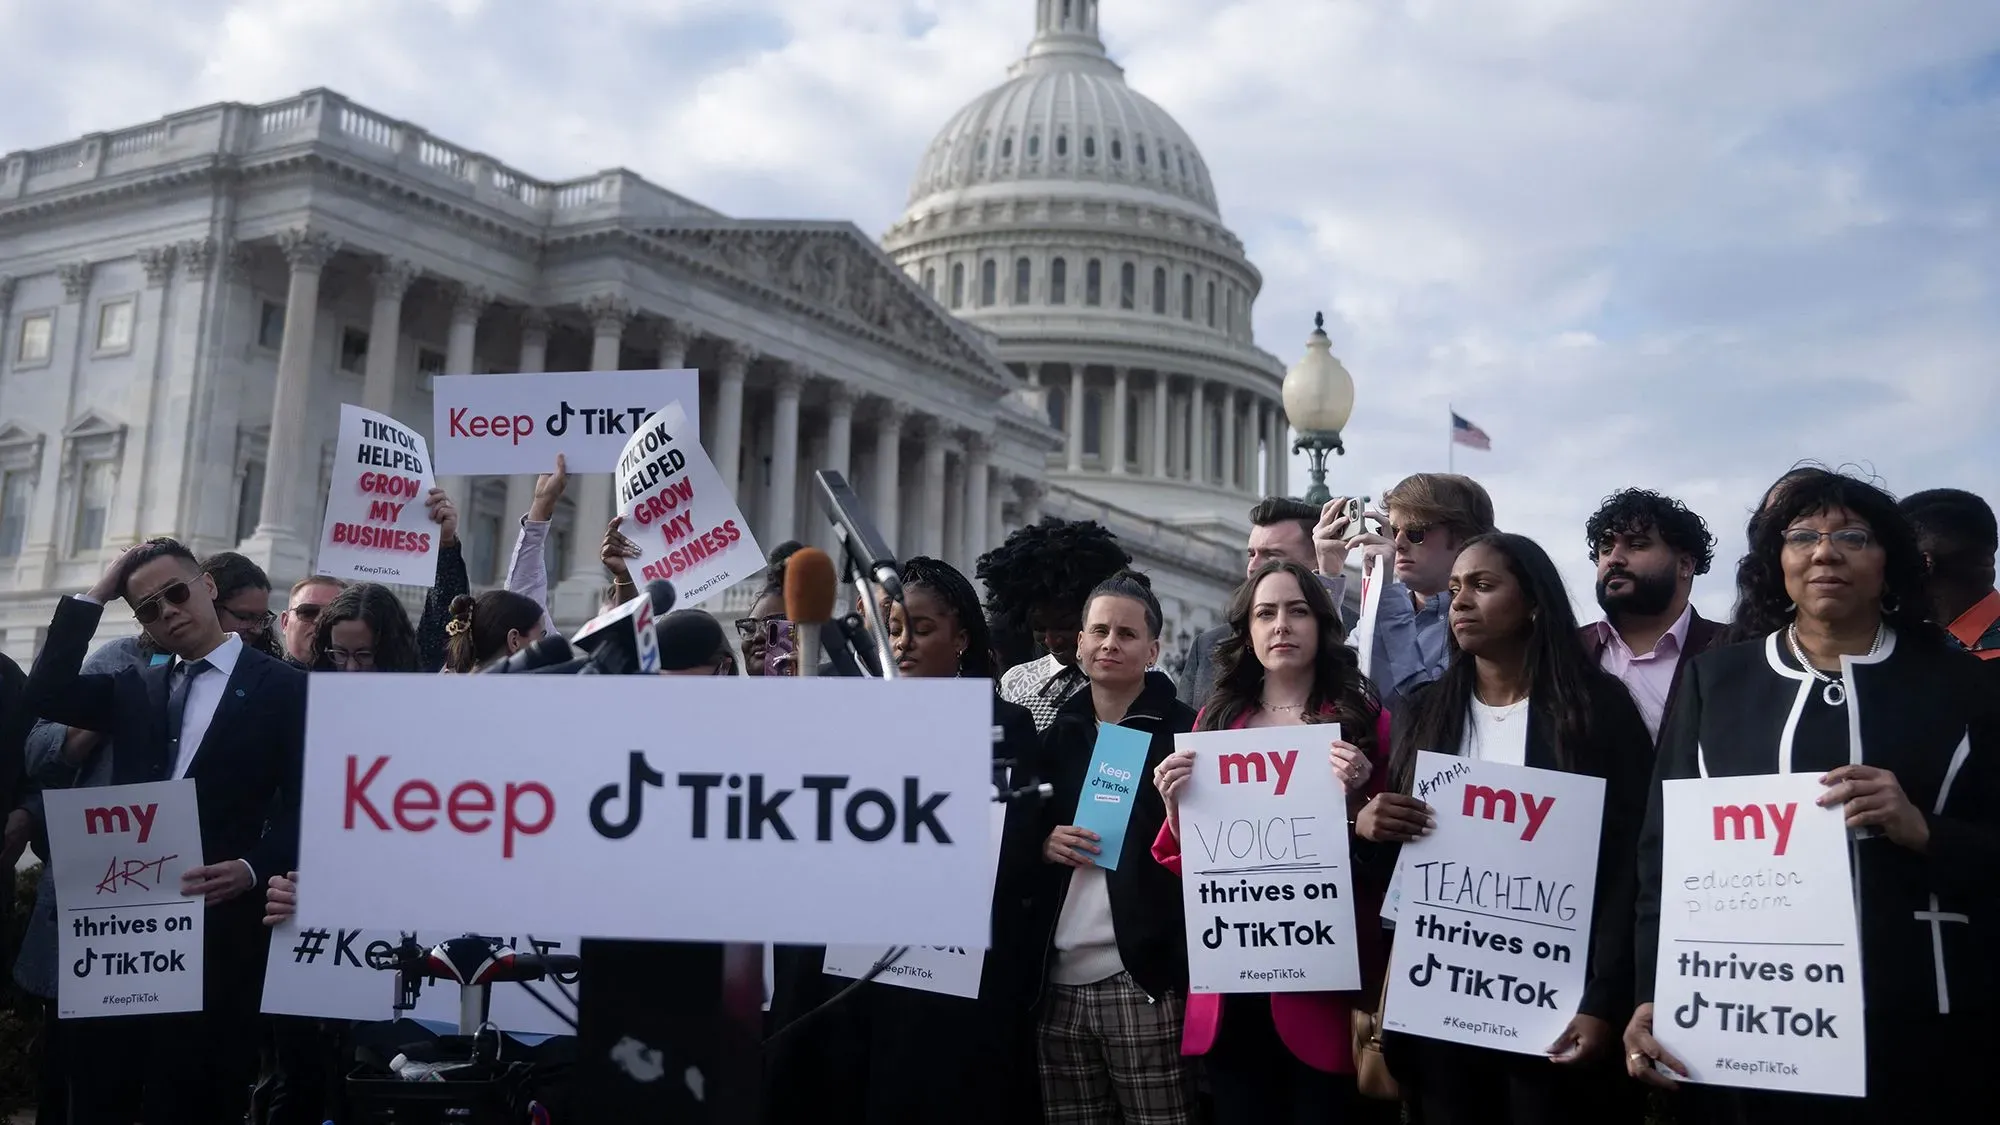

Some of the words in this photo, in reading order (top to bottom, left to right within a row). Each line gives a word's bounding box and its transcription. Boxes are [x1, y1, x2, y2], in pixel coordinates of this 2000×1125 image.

[362, 418, 418, 453] TIKTOK
[450, 407, 534, 445] Keep
[580, 407, 657, 435] TikT
[357, 444, 423, 474] HELPED
[621, 422, 673, 477] TIKTOK
[359, 471, 421, 498] GROW
[622, 448, 686, 504] HELPED
[368, 500, 405, 523] MY
[634, 475, 694, 525] GROW
[332, 522, 431, 553] BUSINESS
[660, 509, 695, 545] MY
[641, 519, 741, 583] BUSINESS
[354, 564, 401, 576] #KeepTikTok
[684, 571, 730, 599] #KeepTikTok
[1099, 761, 1131, 782] Keep
[1101, 780, 1130, 794] TikTok
[1219, 750, 1299, 796] my
[85, 803, 158, 843] my
[342, 754, 556, 859] Keep
[677, 773, 954, 845] TikTok
[1462, 783, 1556, 842] my
[1194, 817, 1317, 863] VOICE
[1713, 803, 1798, 856] my
[96, 854, 179, 895] ART
[1683, 868, 1803, 890] education
[1199, 879, 1295, 904] thrives
[1303, 882, 1338, 900] on
[1414, 861, 1577, 922] TEACHING
[1685, 891, 1792, 921] platform
[73, 914, 157, 937] thrives
[165, 915, 192, 932] on
[1233, 919, 1335, 948] TikTok
[1415, 914, 1523, 955] thrives
[1533, 940, 1571, 963] on
[102, 949, 186, 976] TikTok
[1240, 968, 1306, 982] #KeepTikTok
[1677, 950, 1794, 982] thrives
[1804, 962, 1844, 983] on
[102, 993, 159, 1007] #KeepTikTok
[1447, 964, 1559, 1010] TikTok
[1443, 1016, 1519, 1039] #KeepTikTok
[1715, 1001, 1838, 1039] TikTok
[1715, 1057, 1799, 1076] #KeepTikTok
